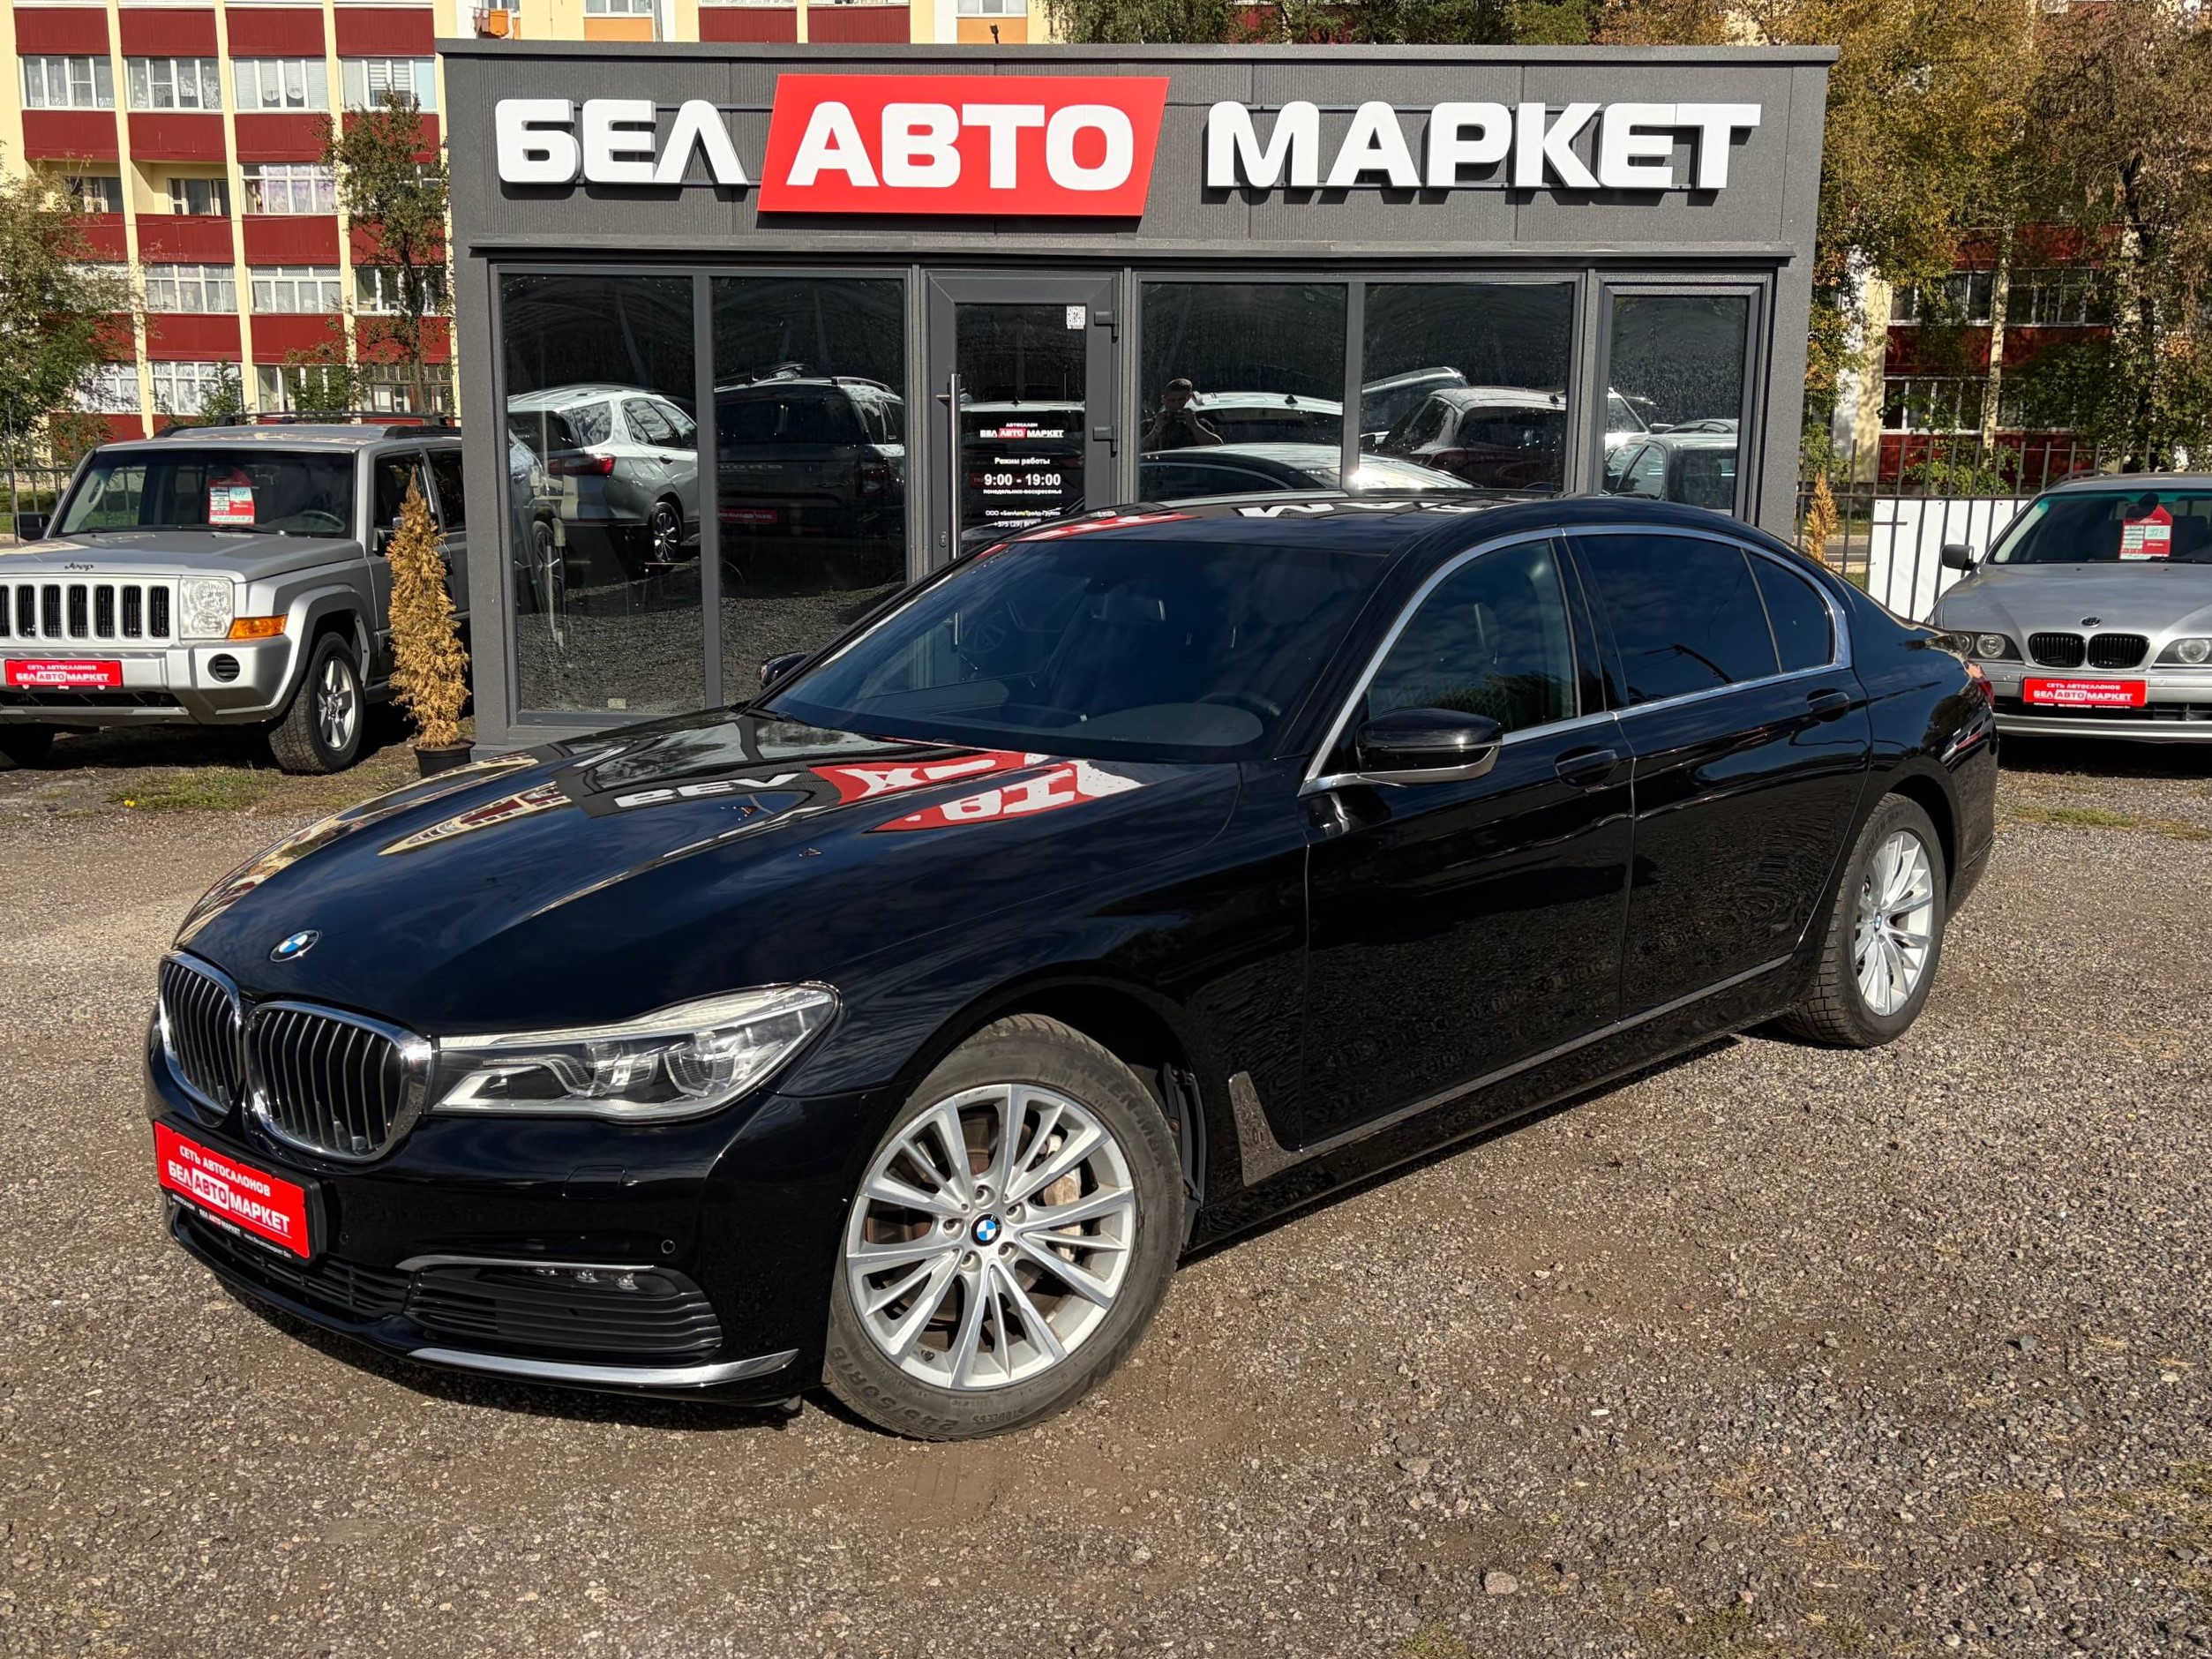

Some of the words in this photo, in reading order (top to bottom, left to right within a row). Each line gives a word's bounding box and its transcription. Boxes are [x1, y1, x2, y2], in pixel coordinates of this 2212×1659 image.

[495, 98, 749, 186] БЕЛ
[786, 100, 1134, 191] АВТО
[1207, 100, 1762, 190] МАРКЕТ
[1021, 457, 1051, 466] работы
[984, 473, 1013, 486] 9:00
[1024, 473, 1061, 486] 19:00
[2056, 691, 2085, 700] АВТО
[2086, 693, 2133, 702] МАРКЕТ
[179, 1145, 202, 1166] СЕТЬ
[202, 1157, 272, 1197] АВТОСАЛОНОВ
[168, 1159, 193, 1188] БЕЛ
[193, 1172, 228, 1205] АВТО
[229, 1191, 291, 1234] МАРКЕТ
